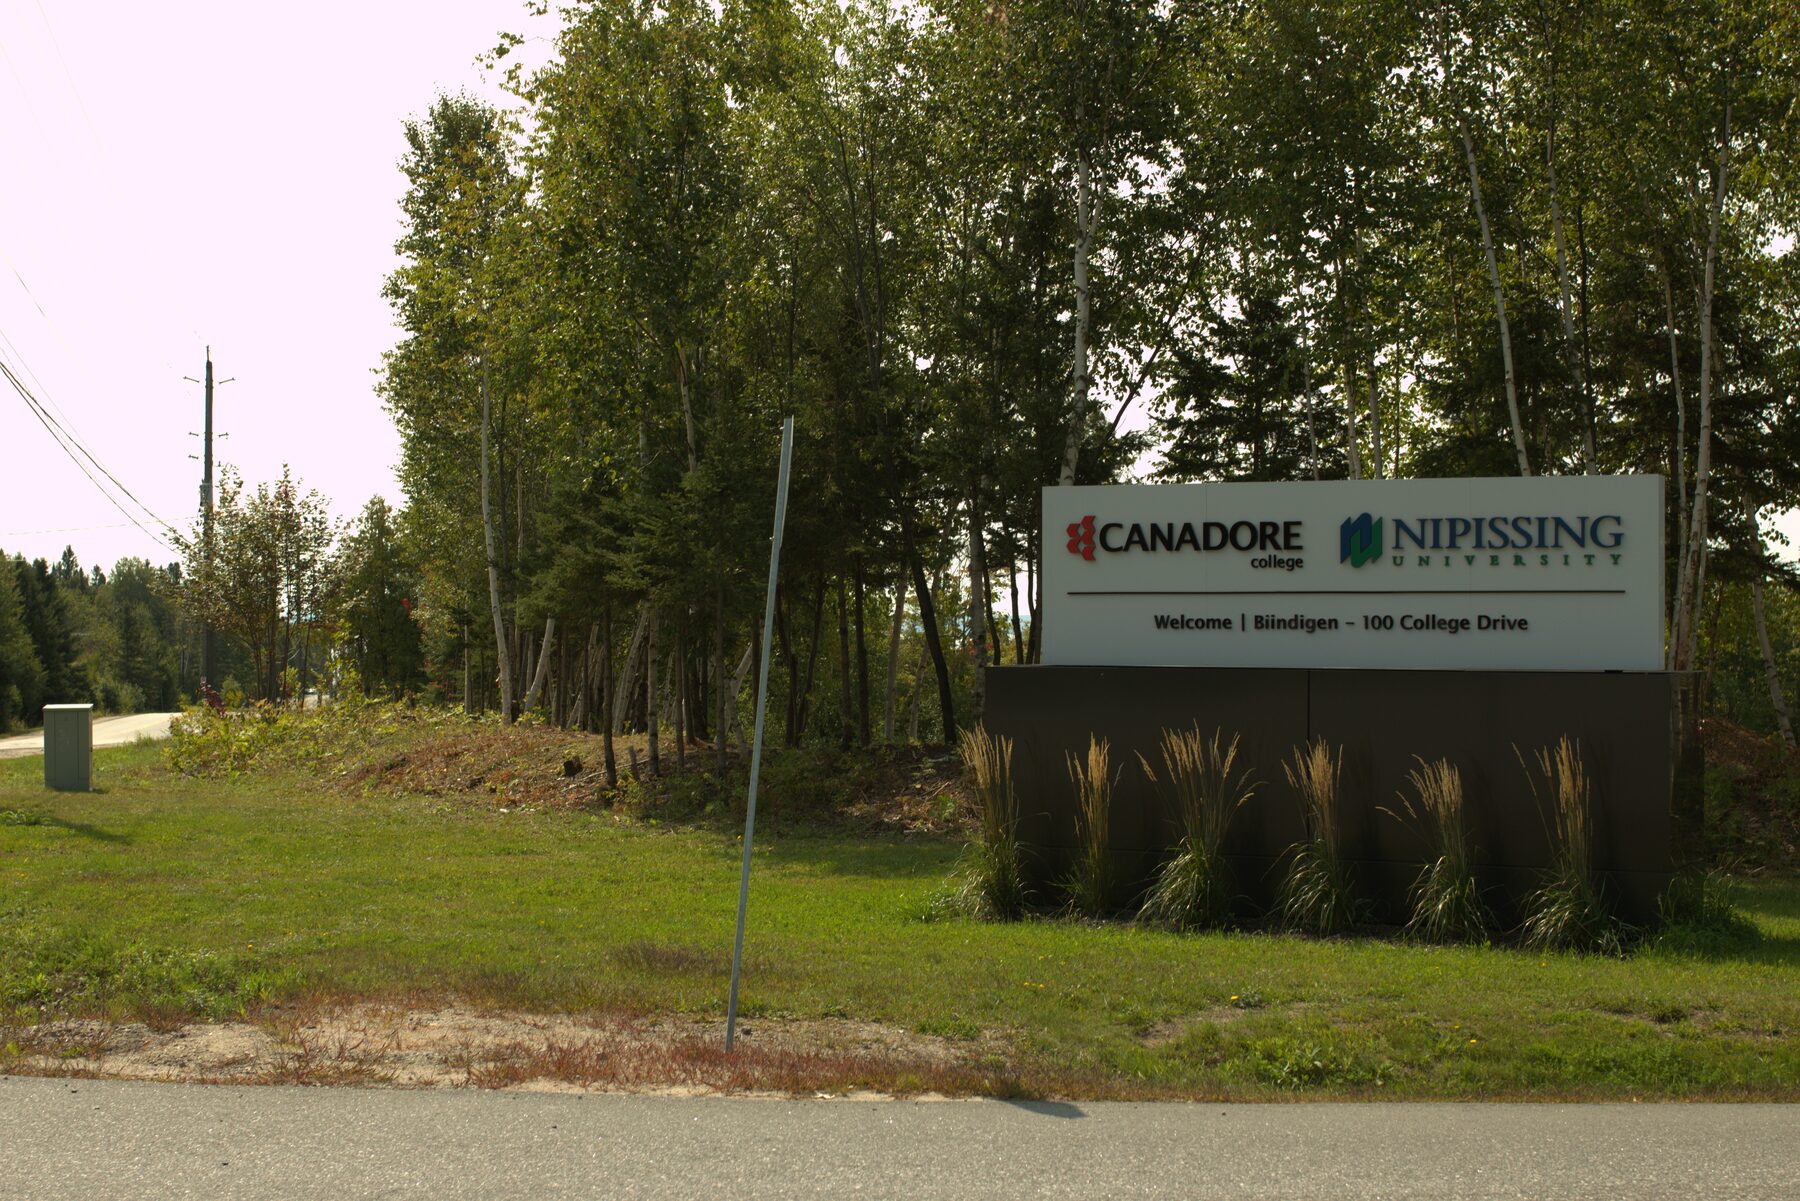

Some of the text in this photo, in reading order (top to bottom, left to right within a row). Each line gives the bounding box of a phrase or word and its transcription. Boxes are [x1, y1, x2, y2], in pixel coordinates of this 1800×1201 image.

[1099, 520, 1304, 553] CANADORE
[1391, 515, 1625, 550] NIPISSING
[1250, 554, 1304, 572] college
[1392, 553, 1623, 567] UNIVERSITY
[1153, 614, 1233, 630] Welcome
[1254, 613, 1339, 634] Biindigen
[1362, 614, 1395, 631] 100
[1399, 613, 1471, 635] College
[1477, 614, 1529, 631] Drive
